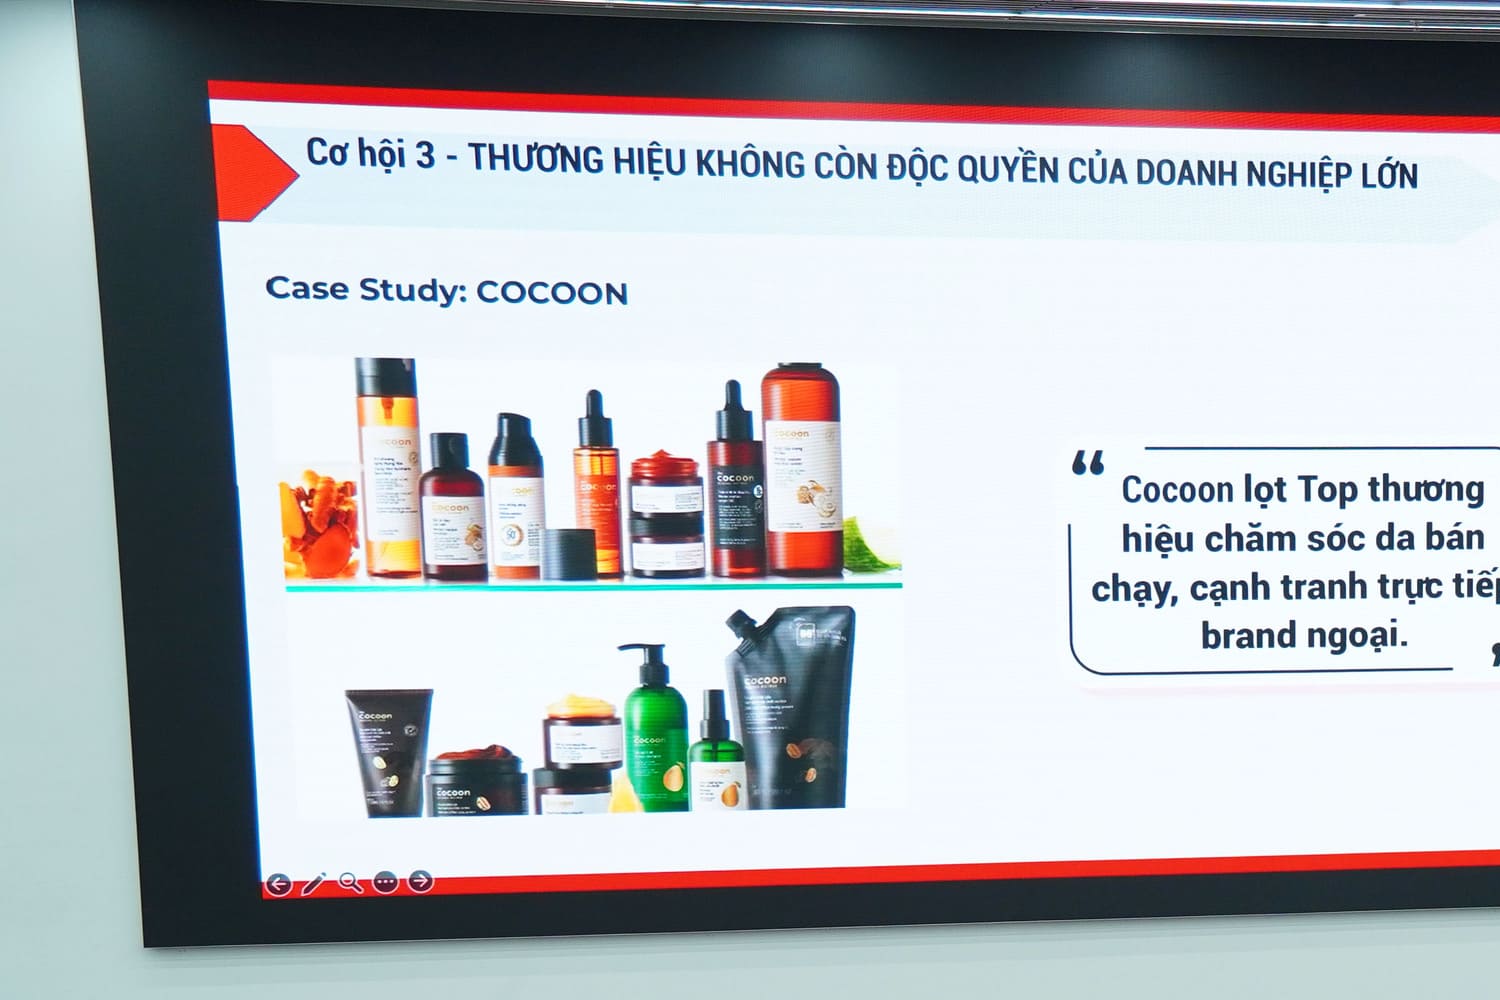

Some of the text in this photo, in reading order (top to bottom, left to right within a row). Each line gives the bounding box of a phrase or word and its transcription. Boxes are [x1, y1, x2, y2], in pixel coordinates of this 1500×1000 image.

[307, 136, 350, 166] Cơ
[357, 136, 406, 174] hội
[415, 140, 435, 169] 3
[467, 141, 604, 174] THƯƠNG
[613, 140, 686, 182] HIỆU
[696, 141, 805, 179] KHÔNG
[814, 143, 877, 180] CÒN
[886, 146, 949, 187] ĐỘC
[958, 146, 1059, 184] QUYỀN
[1068, 148, 1128, 185] CỦA
[1136, 158, 1237, 187] DOANH
[1247, 155, 1353, 194] NGHIỆP
[1362, 156, 1418, 189] LỚN
[265, 275, 628, 309] Case Study: COCOON
[716, 474, 755, 482] cocoon
[1122, 472, 1486, 510] Cocoon lọt Top thương
[1122, 521, 1485, 559] hiệu chăm sóc da bán
[1091, 572, 1179, 609] chạy,
[1190, 571, 1271, 607] cạnh
[1280, 570, 1368, 600] tranh
[1377, 572, 1443, 605] trực
[1201, 618, 1409, 656] brand ngoại.
[743, 676, 787, 685] cocoon
[436, 789, 471, 797] cocoon
